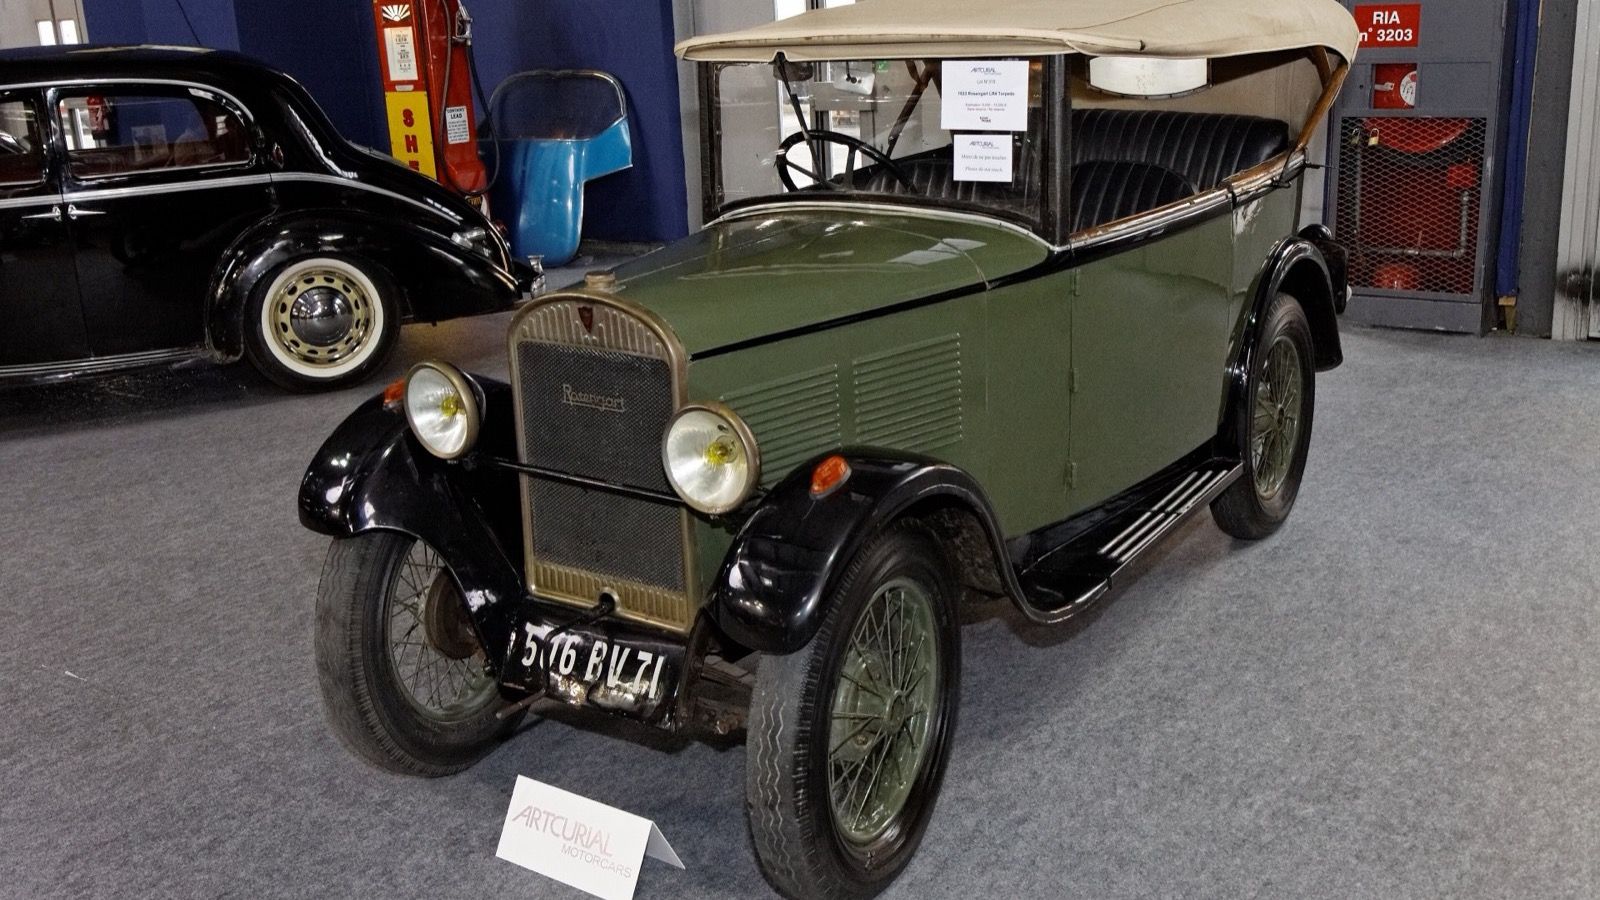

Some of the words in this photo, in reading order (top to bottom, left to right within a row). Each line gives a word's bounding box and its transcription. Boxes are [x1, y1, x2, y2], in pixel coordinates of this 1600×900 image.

[1372, 11, 1401, 25] RIA
[1376, 29, 1413, 42] 3203
[583, 640, 631, 688] BV
[632, 651, 665, 699] 71
[512, 805, 613, 857] ARTCURIAL
[560, 843, 633, 879] MOTORCARS
